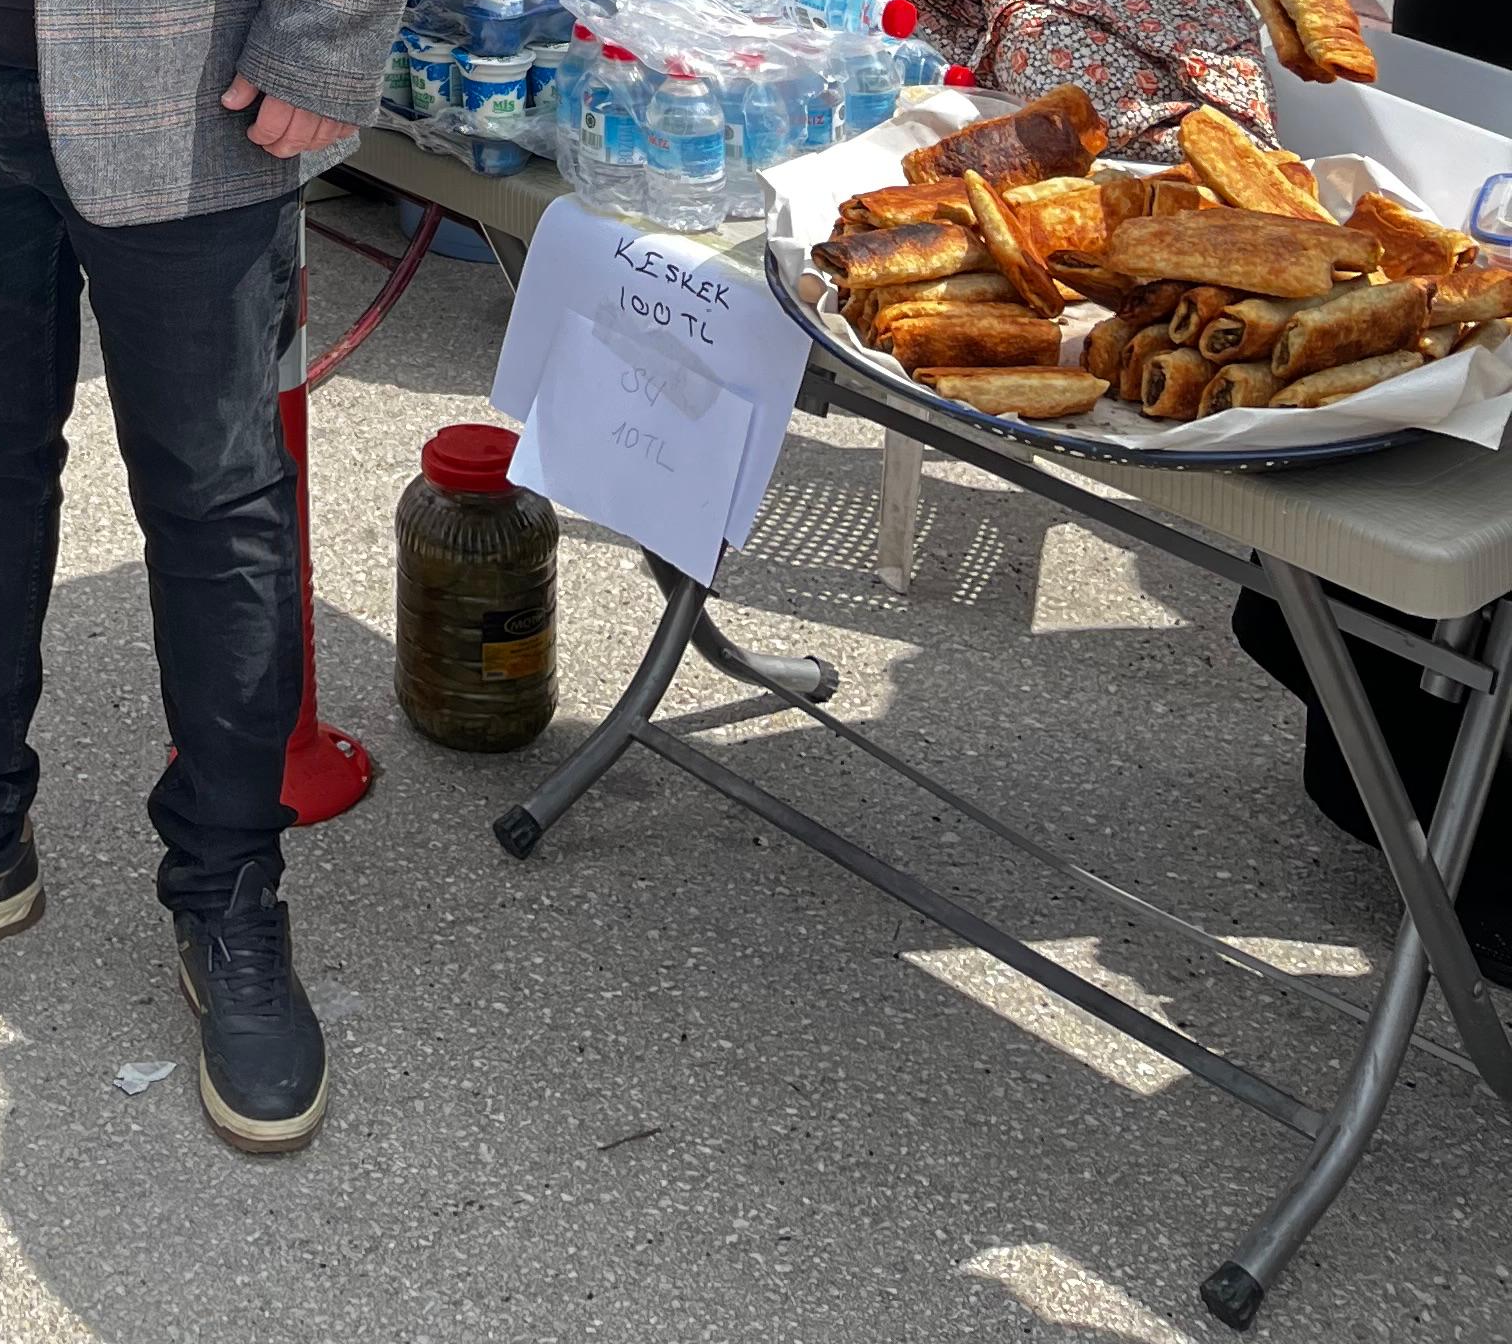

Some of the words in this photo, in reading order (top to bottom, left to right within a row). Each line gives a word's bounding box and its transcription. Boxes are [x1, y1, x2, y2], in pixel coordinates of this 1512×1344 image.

[614, 237, 730, 310] KESKEK
[619, 286, 672, 326] 100
[681, 312, 714, 345] TL
